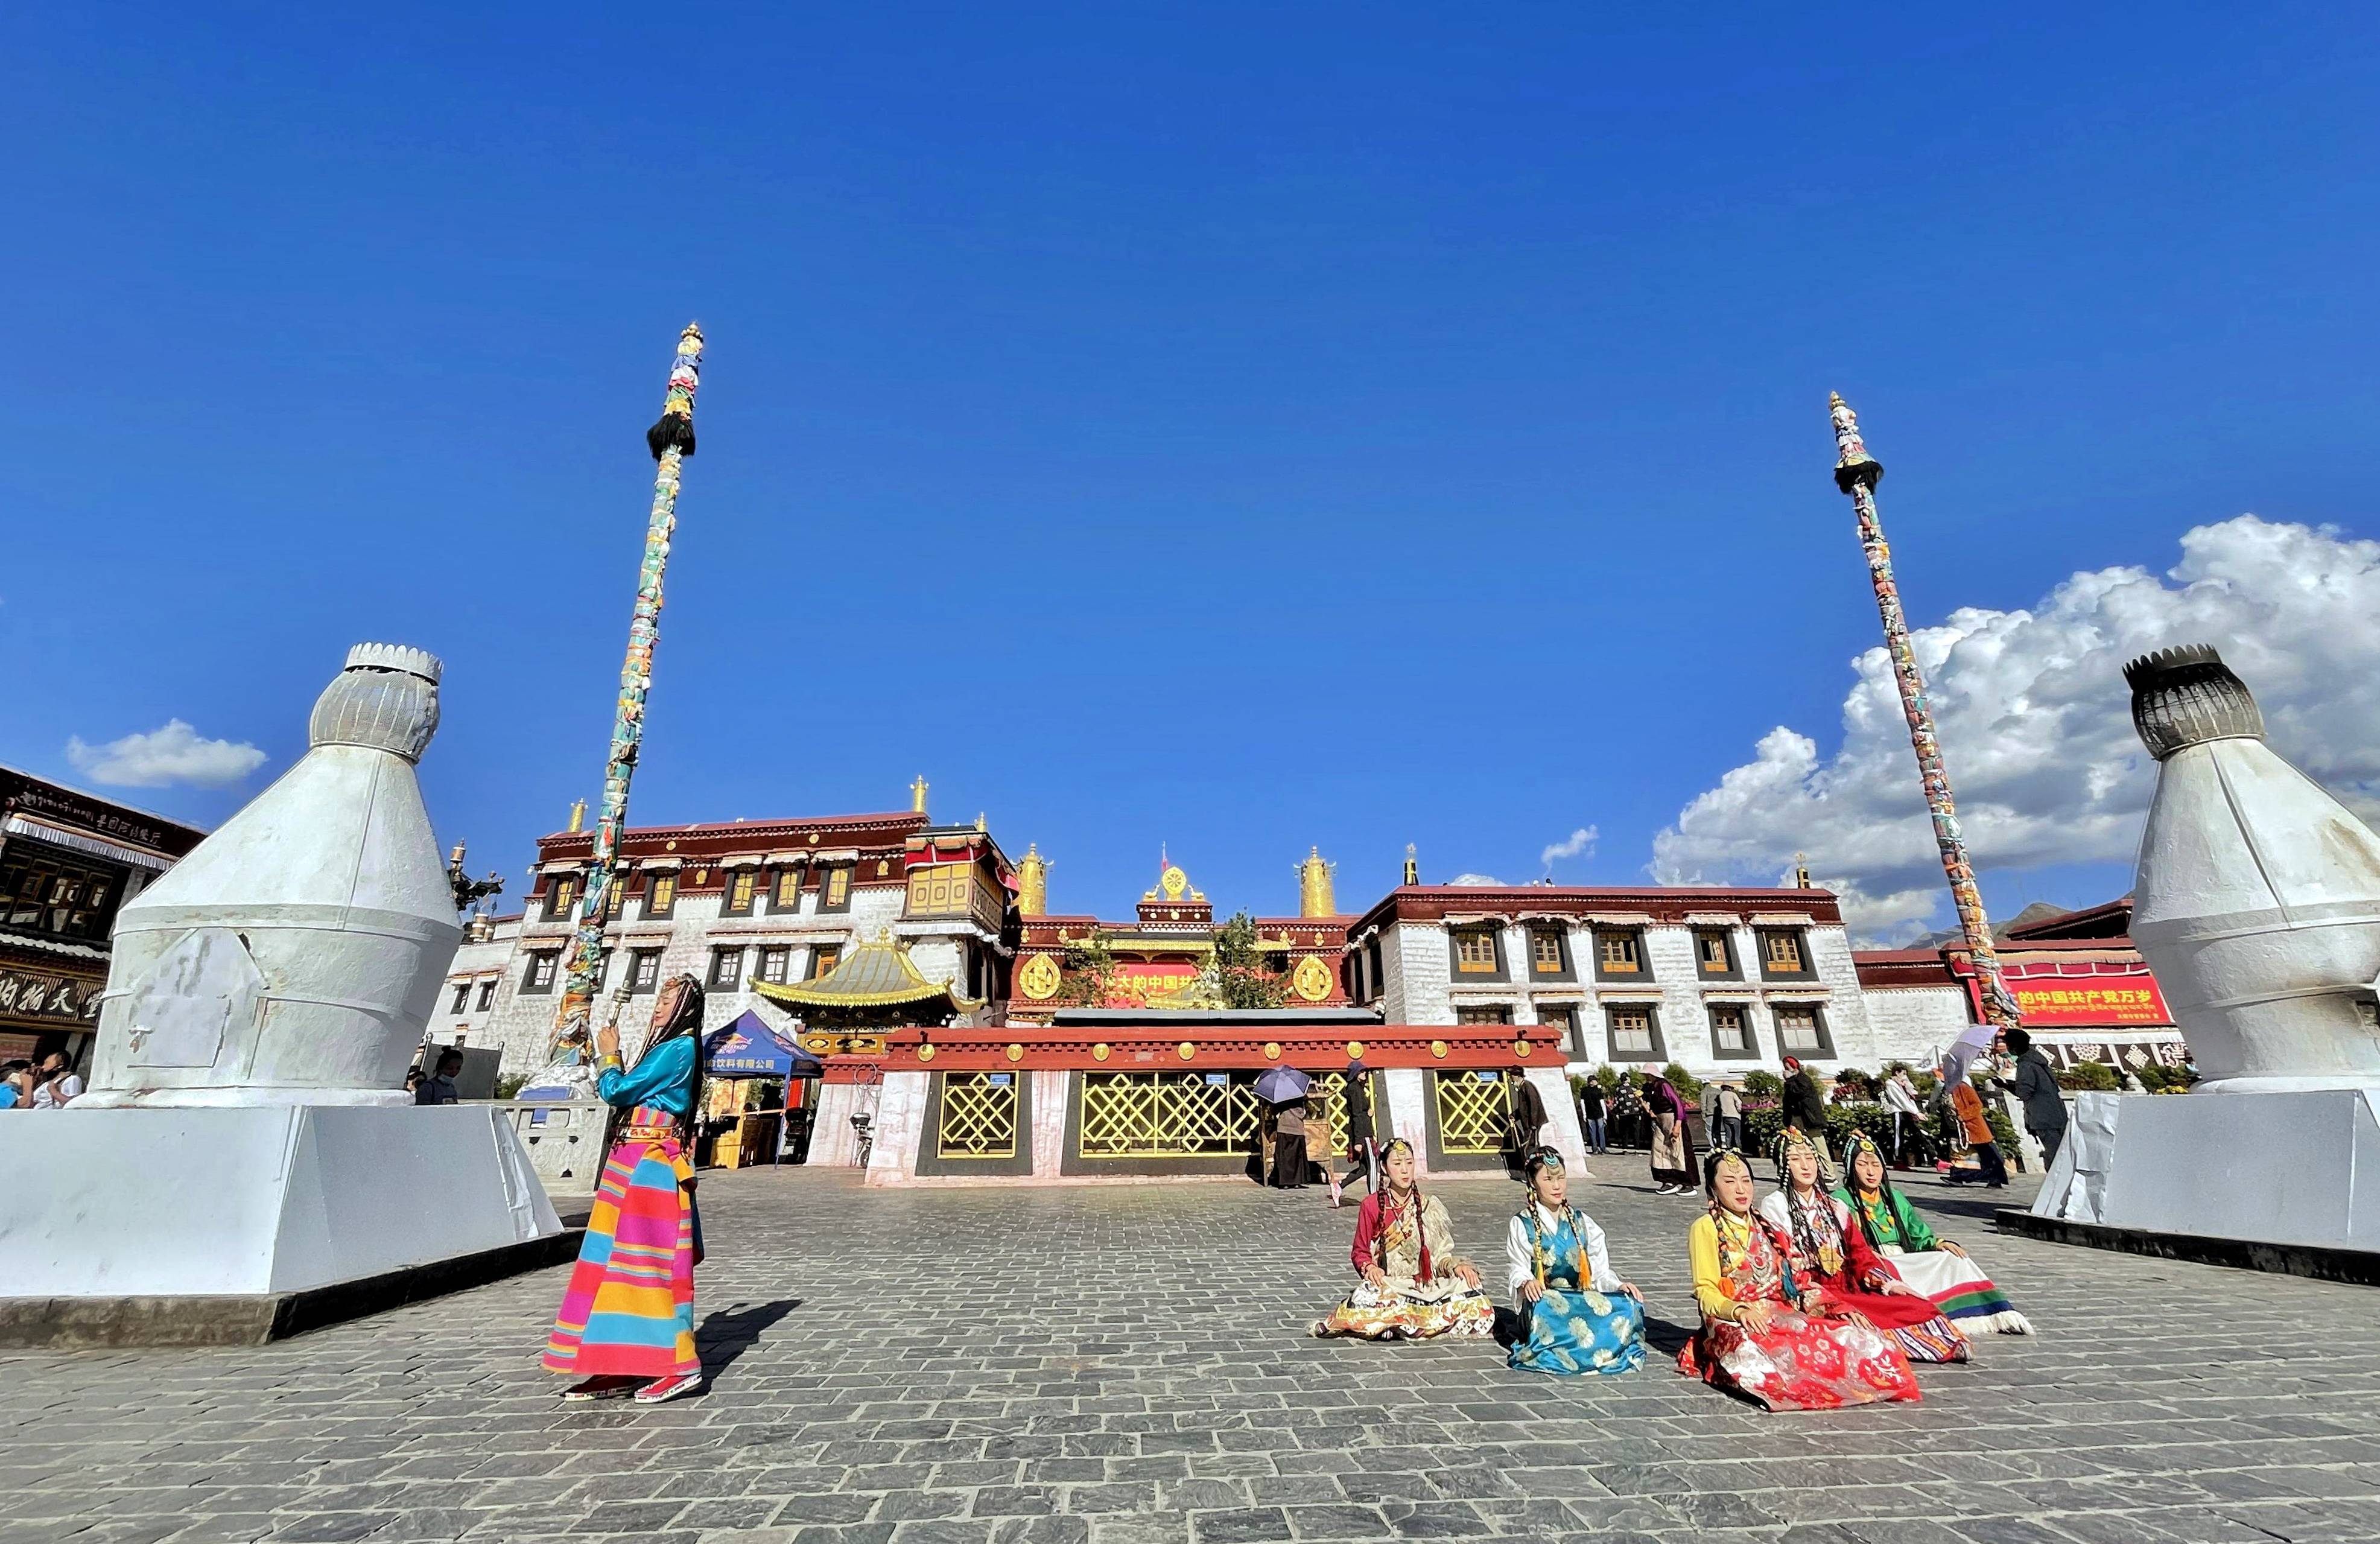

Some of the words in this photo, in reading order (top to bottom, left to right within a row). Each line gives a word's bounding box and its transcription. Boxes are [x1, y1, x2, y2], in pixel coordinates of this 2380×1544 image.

[1105, 975, 1193, 990] 大的中国共
[2014, 990, 2151, 1004] 的中国共产党万岁
[703, 1058, 774, 1070] 饮料有限公司
